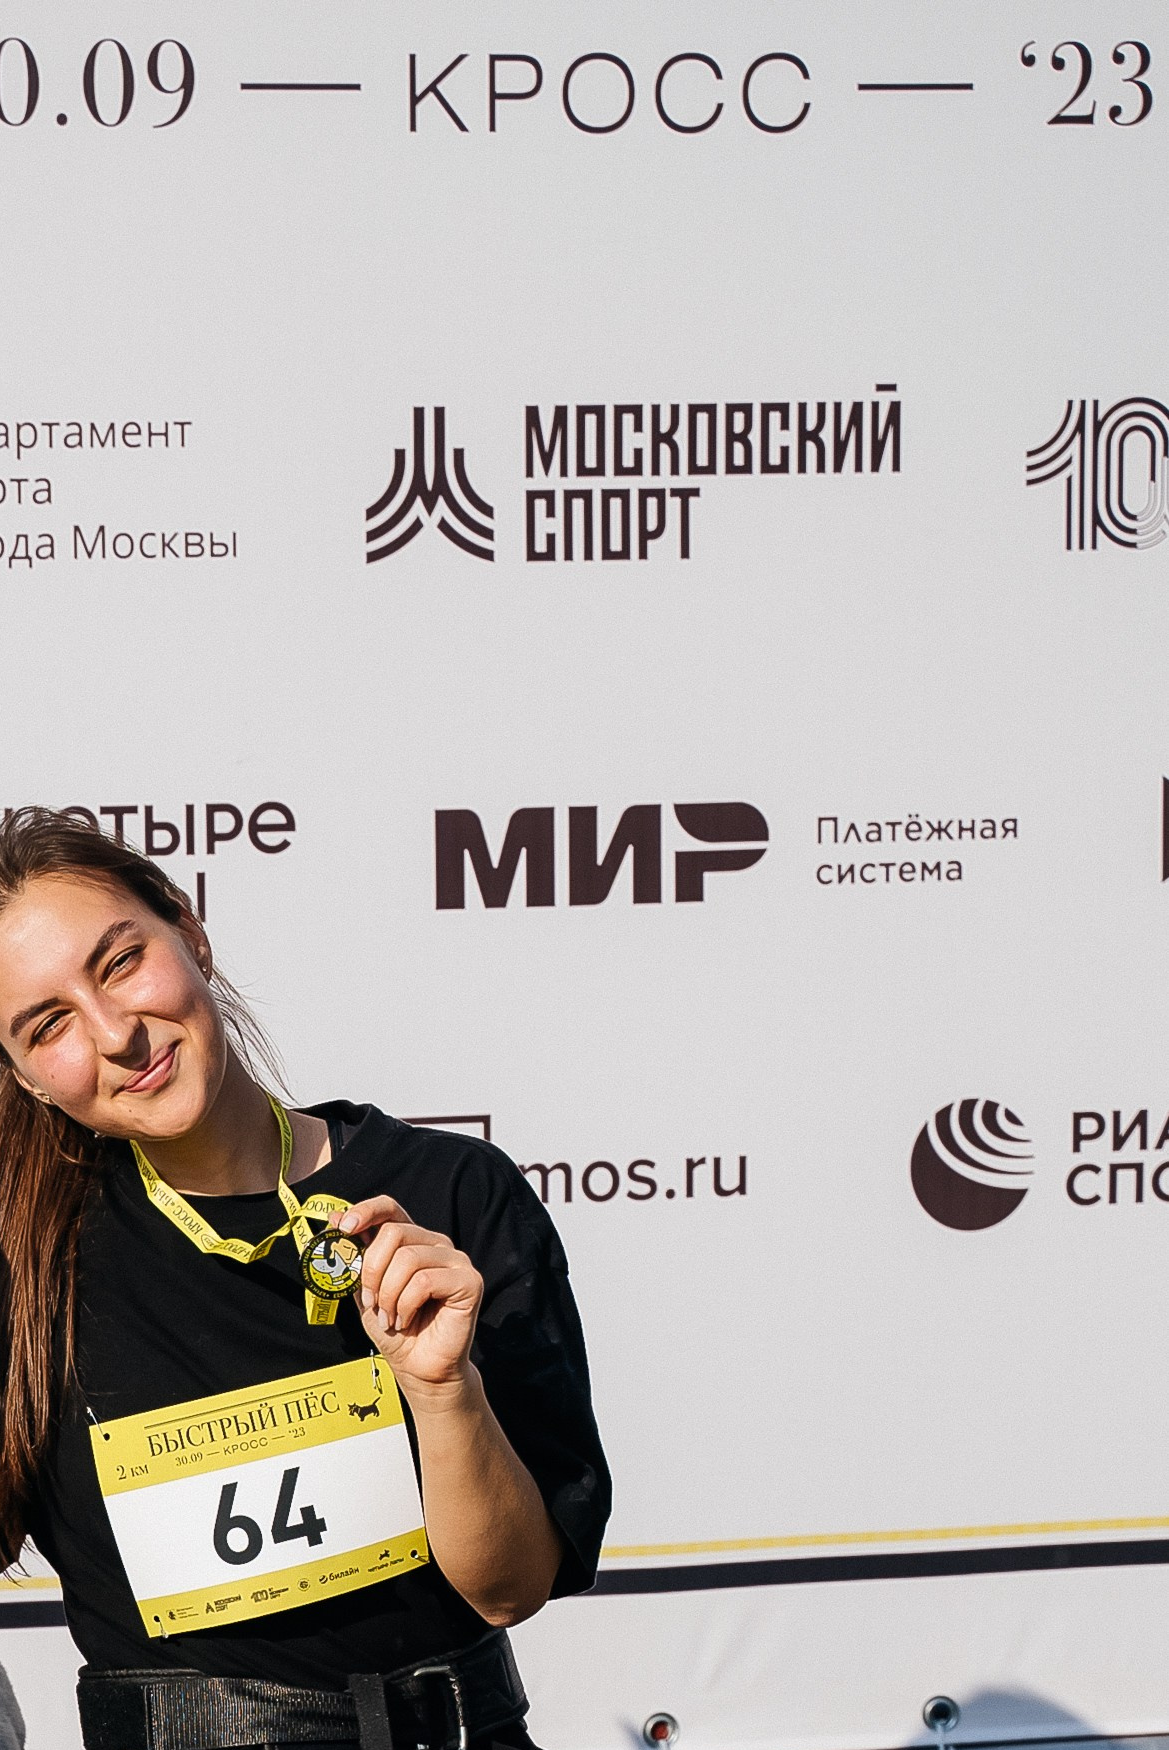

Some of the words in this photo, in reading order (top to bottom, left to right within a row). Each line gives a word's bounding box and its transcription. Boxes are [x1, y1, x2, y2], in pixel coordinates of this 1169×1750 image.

[410, 53, 812, 135] КРОСС
[526, 384, 903, 479] МОСКОВСКИЙ
[74, 526, 238, 560] Москвы
[526, 488, 702, 563] СПОРТ
[818, 814, 1019, 845] Платёжная
[435, 802, 771, 912] МИР
[817, 861, 963, 886] система
[518, 1154, 748, 1204] mos.ru
[146, 1403, 278, 1458] БЫСТРЫЙ
[283, 1390, 341, 1424] ПЁС
[116, 1464, 128, 1481] 2
[175, 1452, 204, 1467] 30.09
[223, 1436, 269, 1456] КРОСС
[212, 1465, 328, 1566] 64
[328, 1567, 360, 1581] билайн
